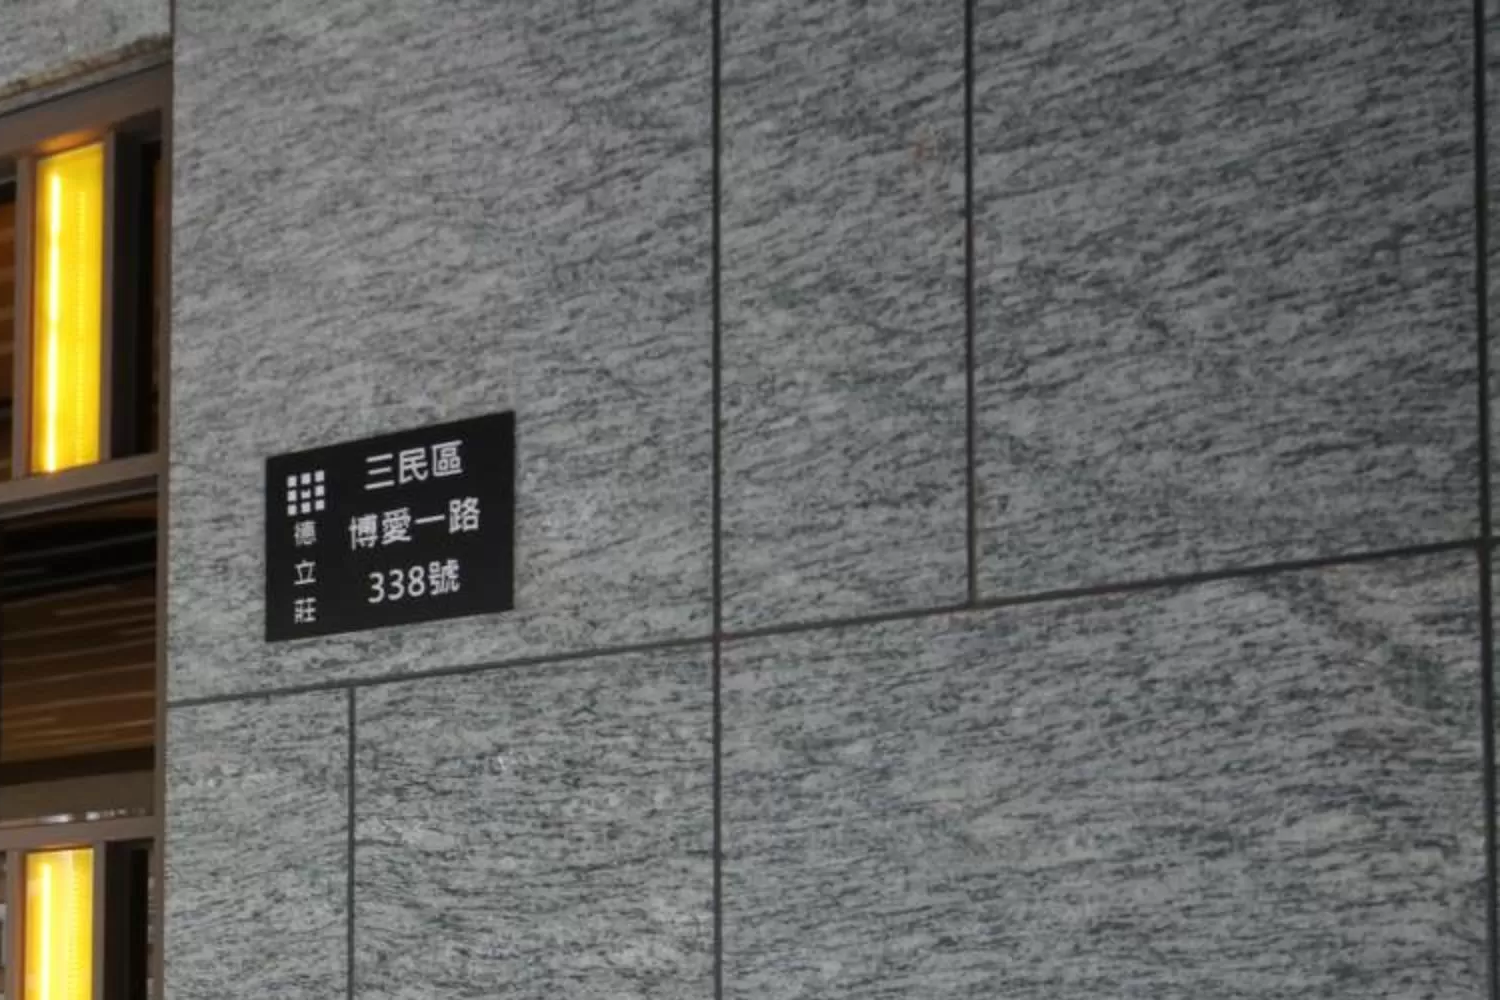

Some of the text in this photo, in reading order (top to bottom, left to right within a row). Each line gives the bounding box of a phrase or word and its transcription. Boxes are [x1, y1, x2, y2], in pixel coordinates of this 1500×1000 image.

[364, 439, 464, 490] 三民區
[348, 496, 481, 551] 博愛一路
[367, 558, 461, 604] 338號
